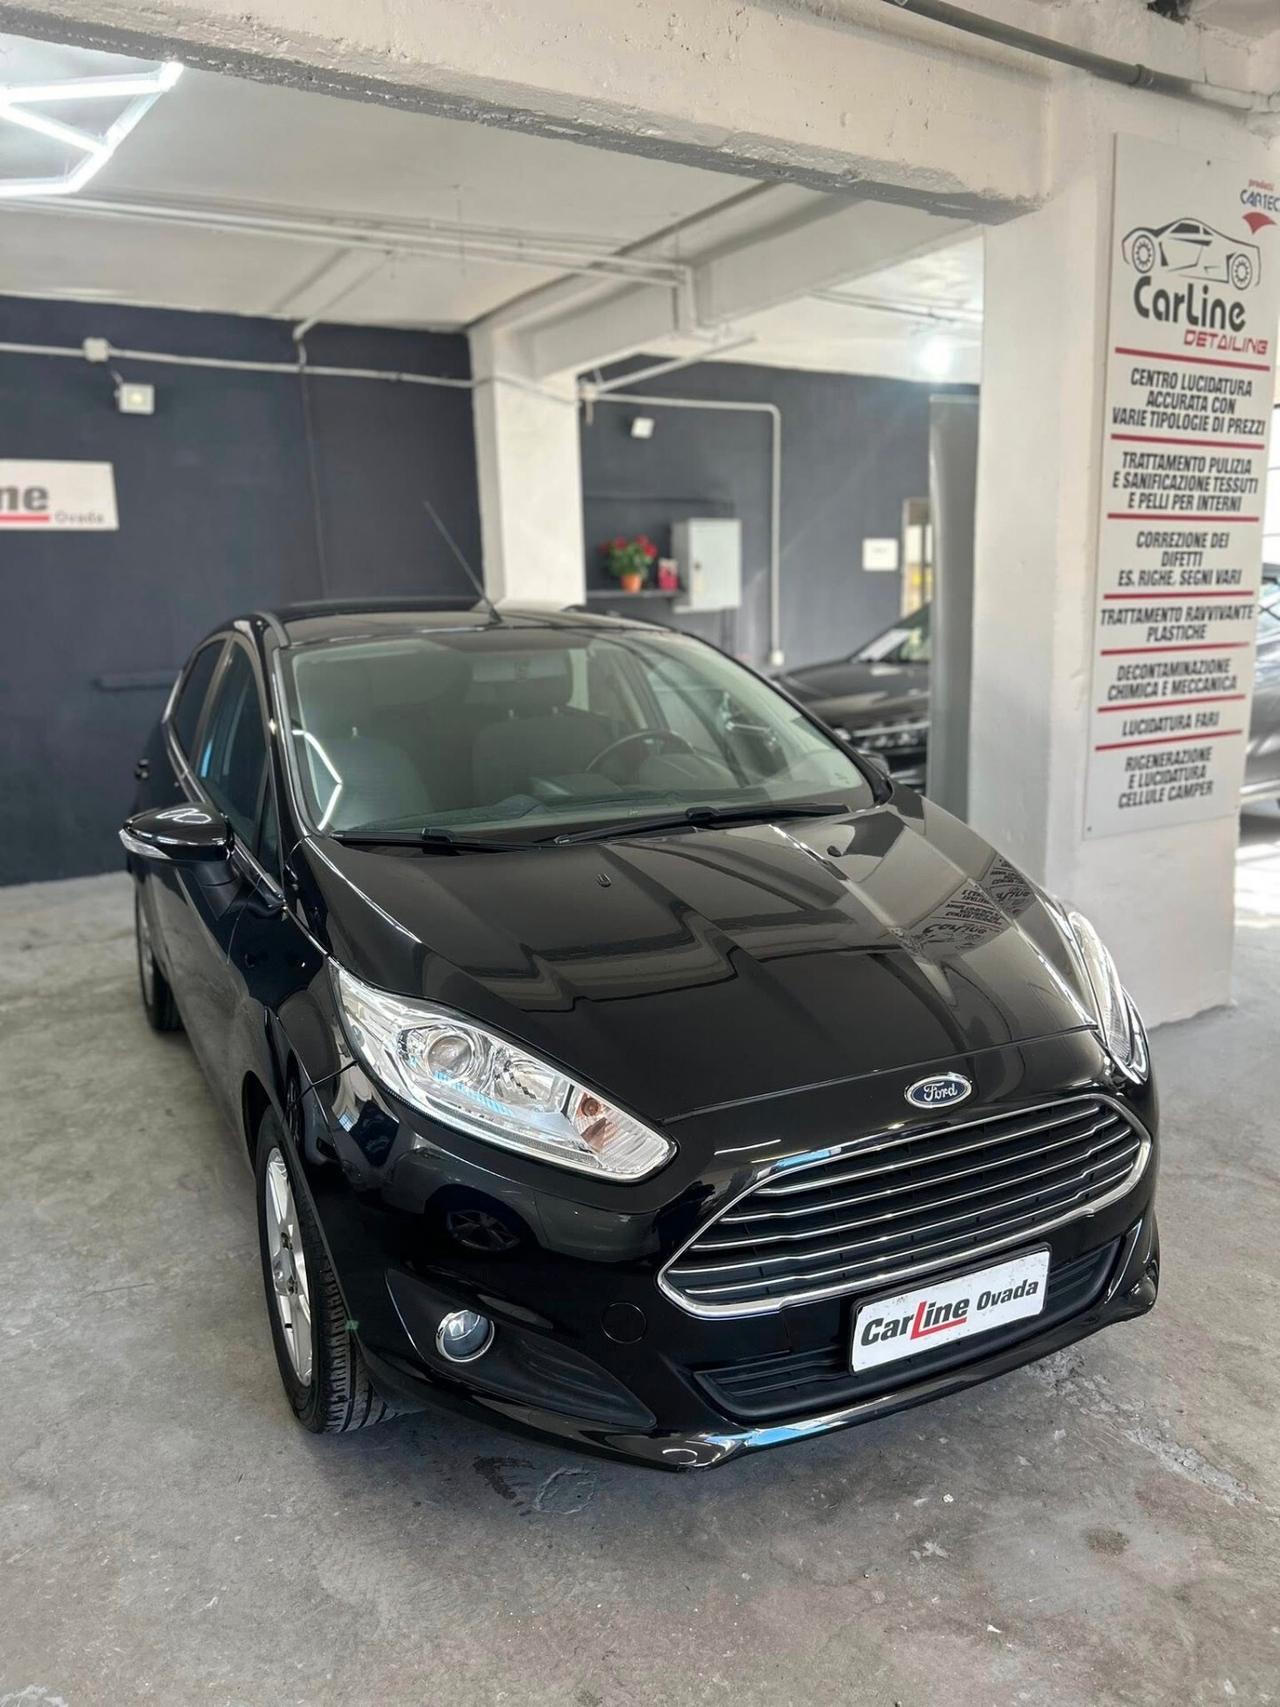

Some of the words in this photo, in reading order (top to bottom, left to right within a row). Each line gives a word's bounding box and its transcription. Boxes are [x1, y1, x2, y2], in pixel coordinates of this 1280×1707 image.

[1134, 275, 1246, 332] CarLine
[1184, 329, 1268, 355] DETAILING
[1130, 368, 1178, 390] CENTRO
[1181, 373, 1253, 396] LUCIDATURA
[1146, 390, 1208, 412] ACCURATA
[1211, 397, 1237, 415] CON
[1112, 407, 1147, 427] VARIE
[1150, 410, 1210, 432] TIPOLOGIE
[1212, 416, 1225, 433] DI
[1227, 418, 1266, 436] PREZZI
[1122, 452, 1206, 473] TRATTAMENTO
[1208, 457, 1252, 475] PULIZIA
[1112, 471, 1120, 489] E
[1123, 472, 1212, 492] SANIFICAZIONE
[1213, 476, 1259, 494] TESSUTI
[1128, 492, 1136, 509] E
[1138, 492, 1170, 510] PELLI
[1171, 494, 1195, 511] PER
[1196, 495, 1242, 512] INTERNI
[1136, 531, 1207, 548] CORREZIONE
[1210, 532, 1230, 549] DEI
[1161, 551, 1203, 568] DIFETTI
[1179, 569, 1213, 586] SEGNI
[1215, 569, 1242, 585] VARI
[1101, 607, 1182, 625] TRATTAMENTO
[1184, 604, 1255, 622] RAVVIVANTE
[1146, 624, 1208, 642] PLASTICHE
[1117, 658, 1232, 681] DECONTAMINAZIONE
[1107, 681, 1159, 701] CHIMICA
[1162, 680, 1169, 697] E
[1171, 676, 1238, 695] MECCANICA
[1122, 714, 1192, 737] LUCIDATURA
[1195, 712, 1220, 728] FARI
[1125, 746, 1213, 772] RIGENERAZIONE
[1128, 774, 1135, 790] E
[1138, 765, 1207, 788] LUCIDATURA
[1118, 789, 1164, 809] CELLULE
[1167, 781, 1214, 801] CAMPER
[922, 1081, 958, 1102] Ford
[860, 1298, 970, 1347] CarLine
[976, 1279, 1039, 1312] Ovada
